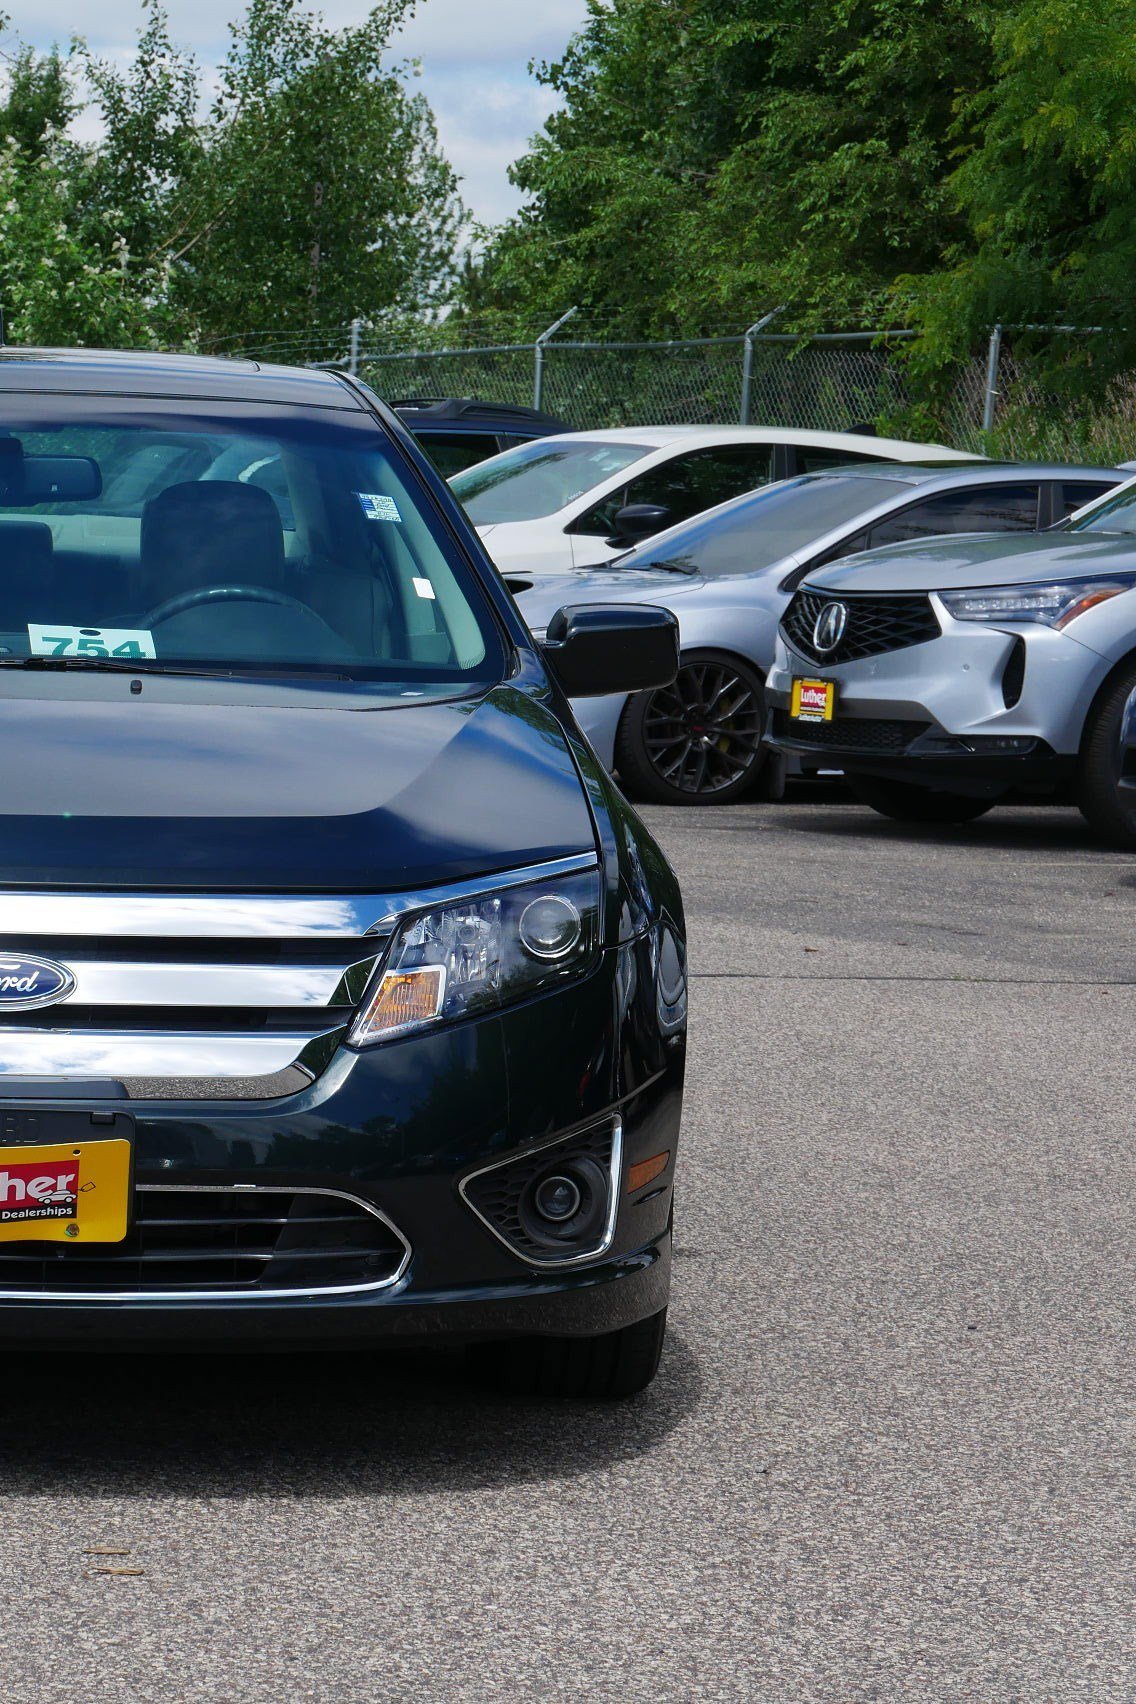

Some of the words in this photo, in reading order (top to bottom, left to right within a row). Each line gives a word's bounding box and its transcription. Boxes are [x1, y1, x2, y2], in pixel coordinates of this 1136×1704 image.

[42, 636, 147, 658] 754
[801, 689, 826, 705] Luther
[1, 1206, 73, 1220] Dealerships
